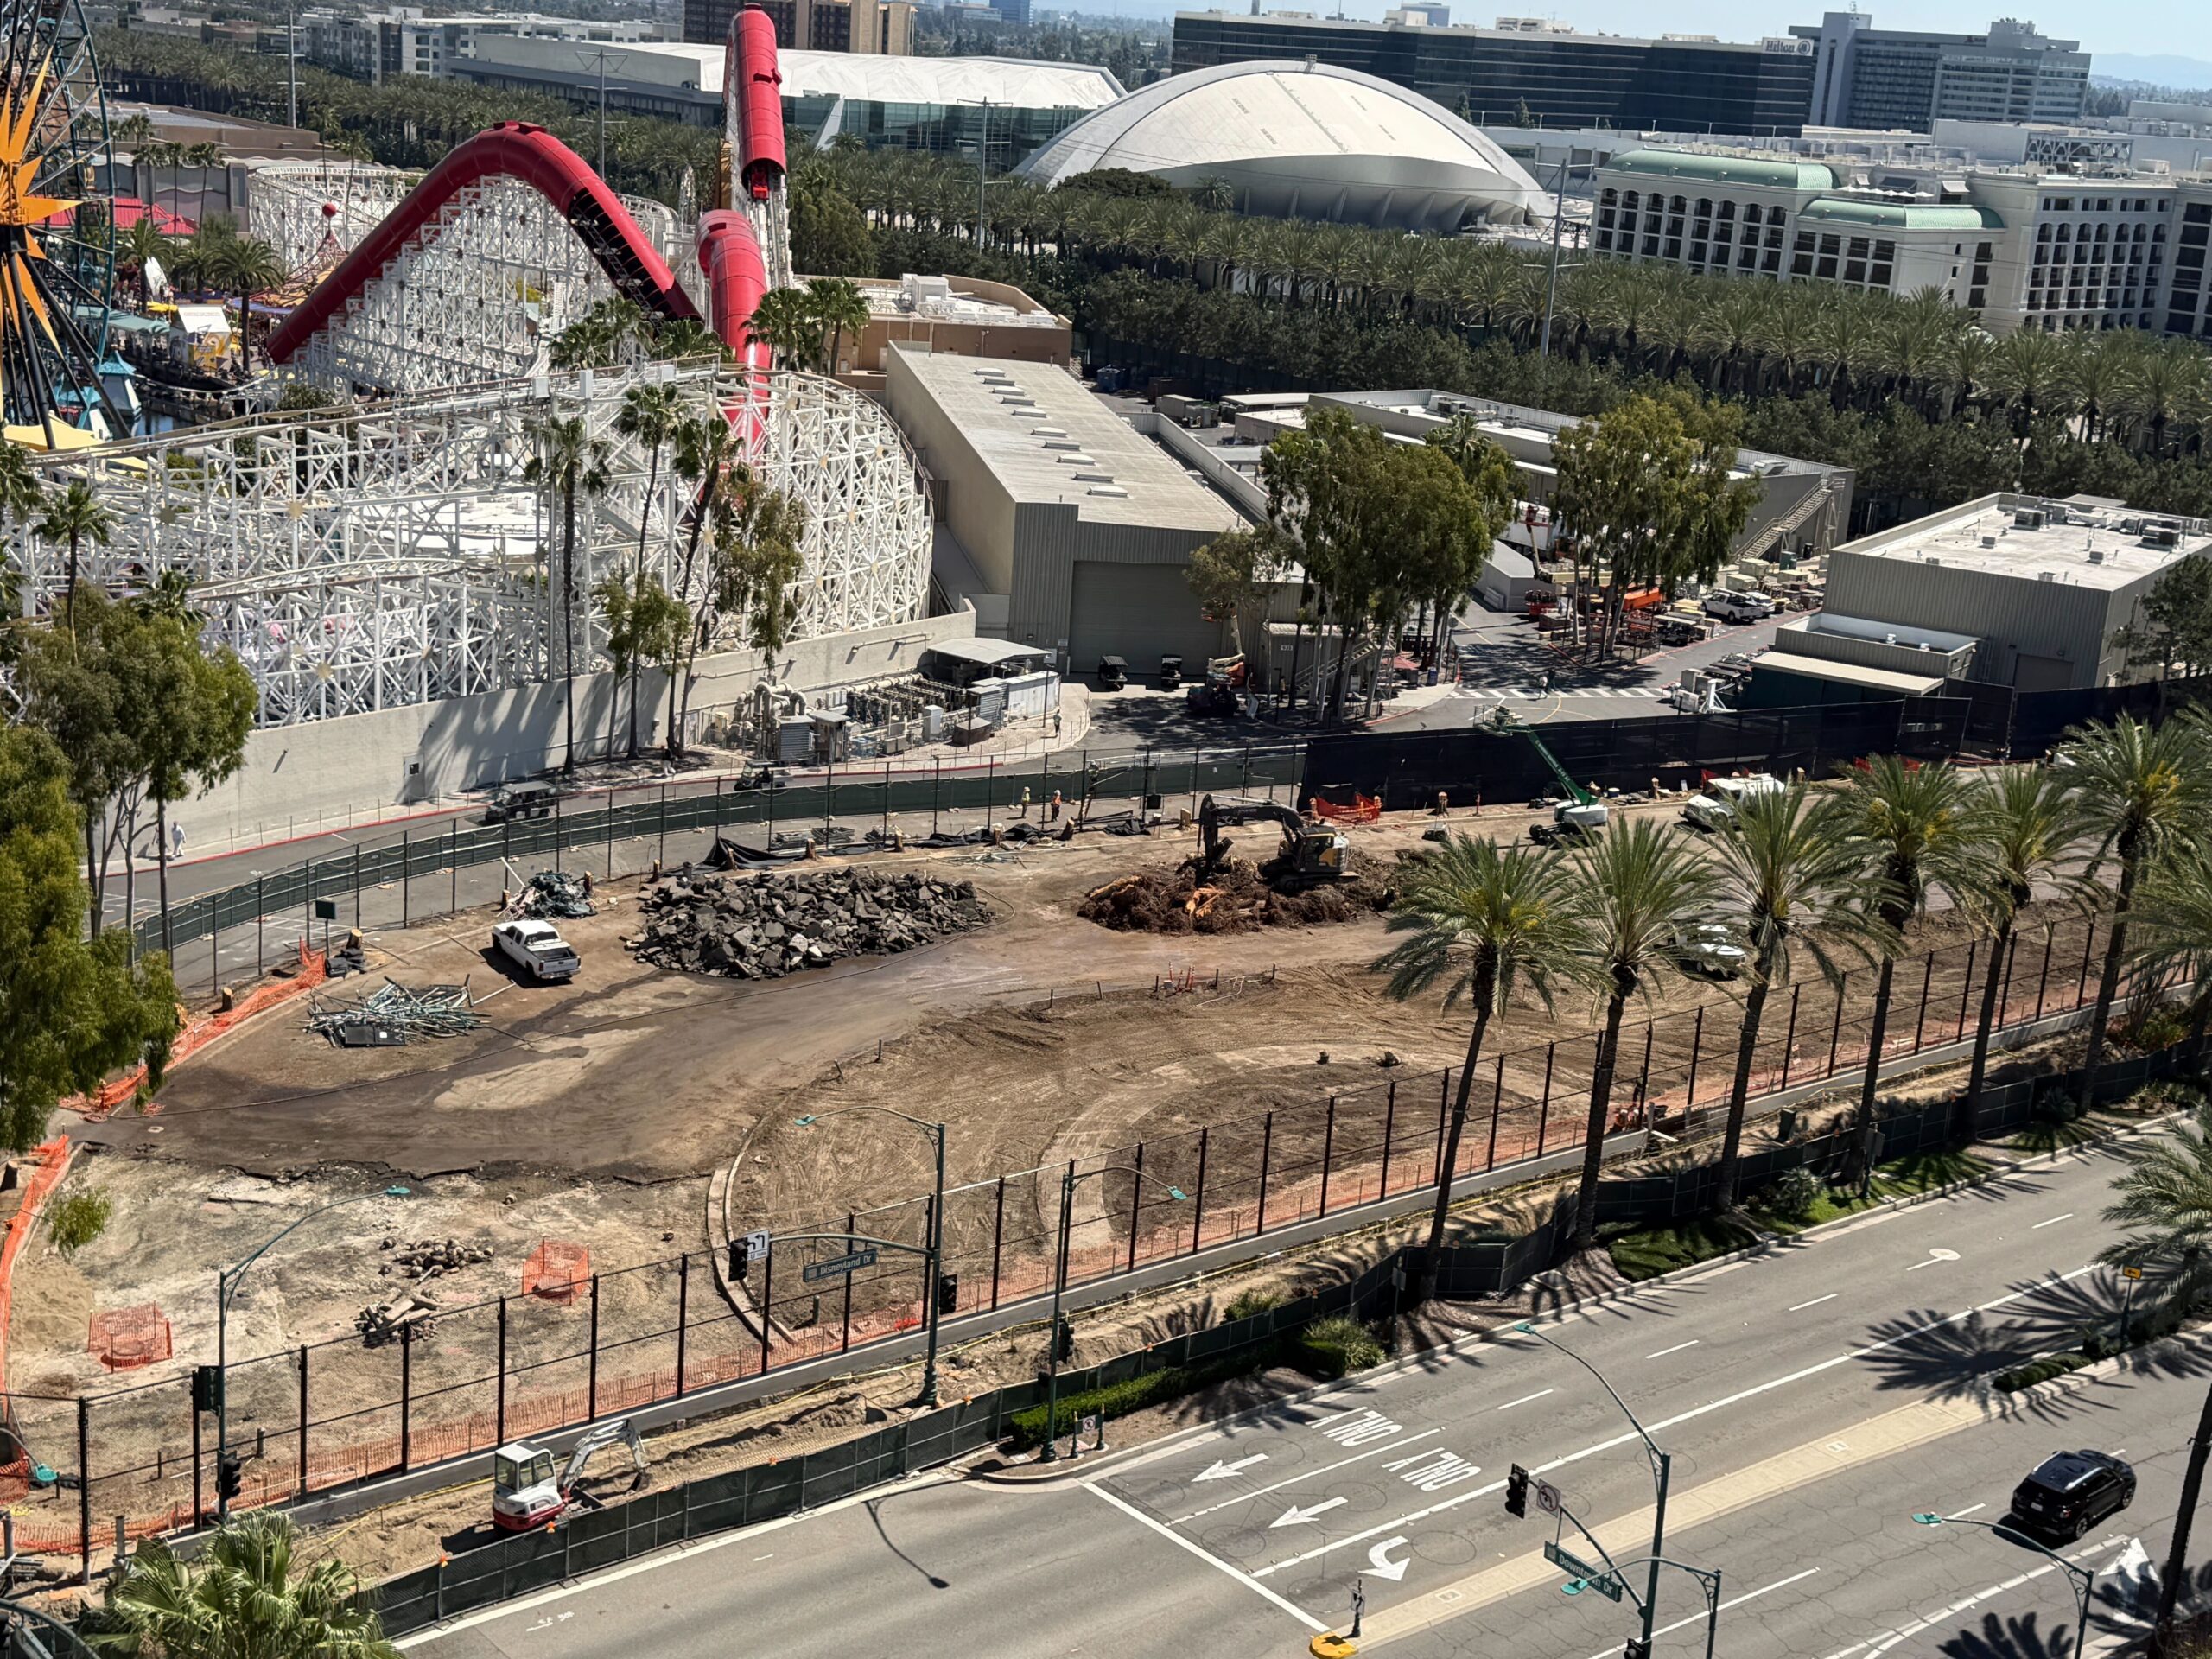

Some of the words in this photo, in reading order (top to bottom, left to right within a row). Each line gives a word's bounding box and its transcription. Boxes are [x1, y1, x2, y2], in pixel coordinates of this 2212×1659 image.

[1765, 40, 1795, 53] Hilton
[820, 1256, 861, 1274] Disneyland
[863, 1254, 872, 1264] Dr
[1305, 1406, 1403, 1447] ONLY
[1381, 1447, 1482, 1491] ONLY
[1559, 1554, 1601, 1587] Downton
[1603, 1582, 1613, 1594] Dr
